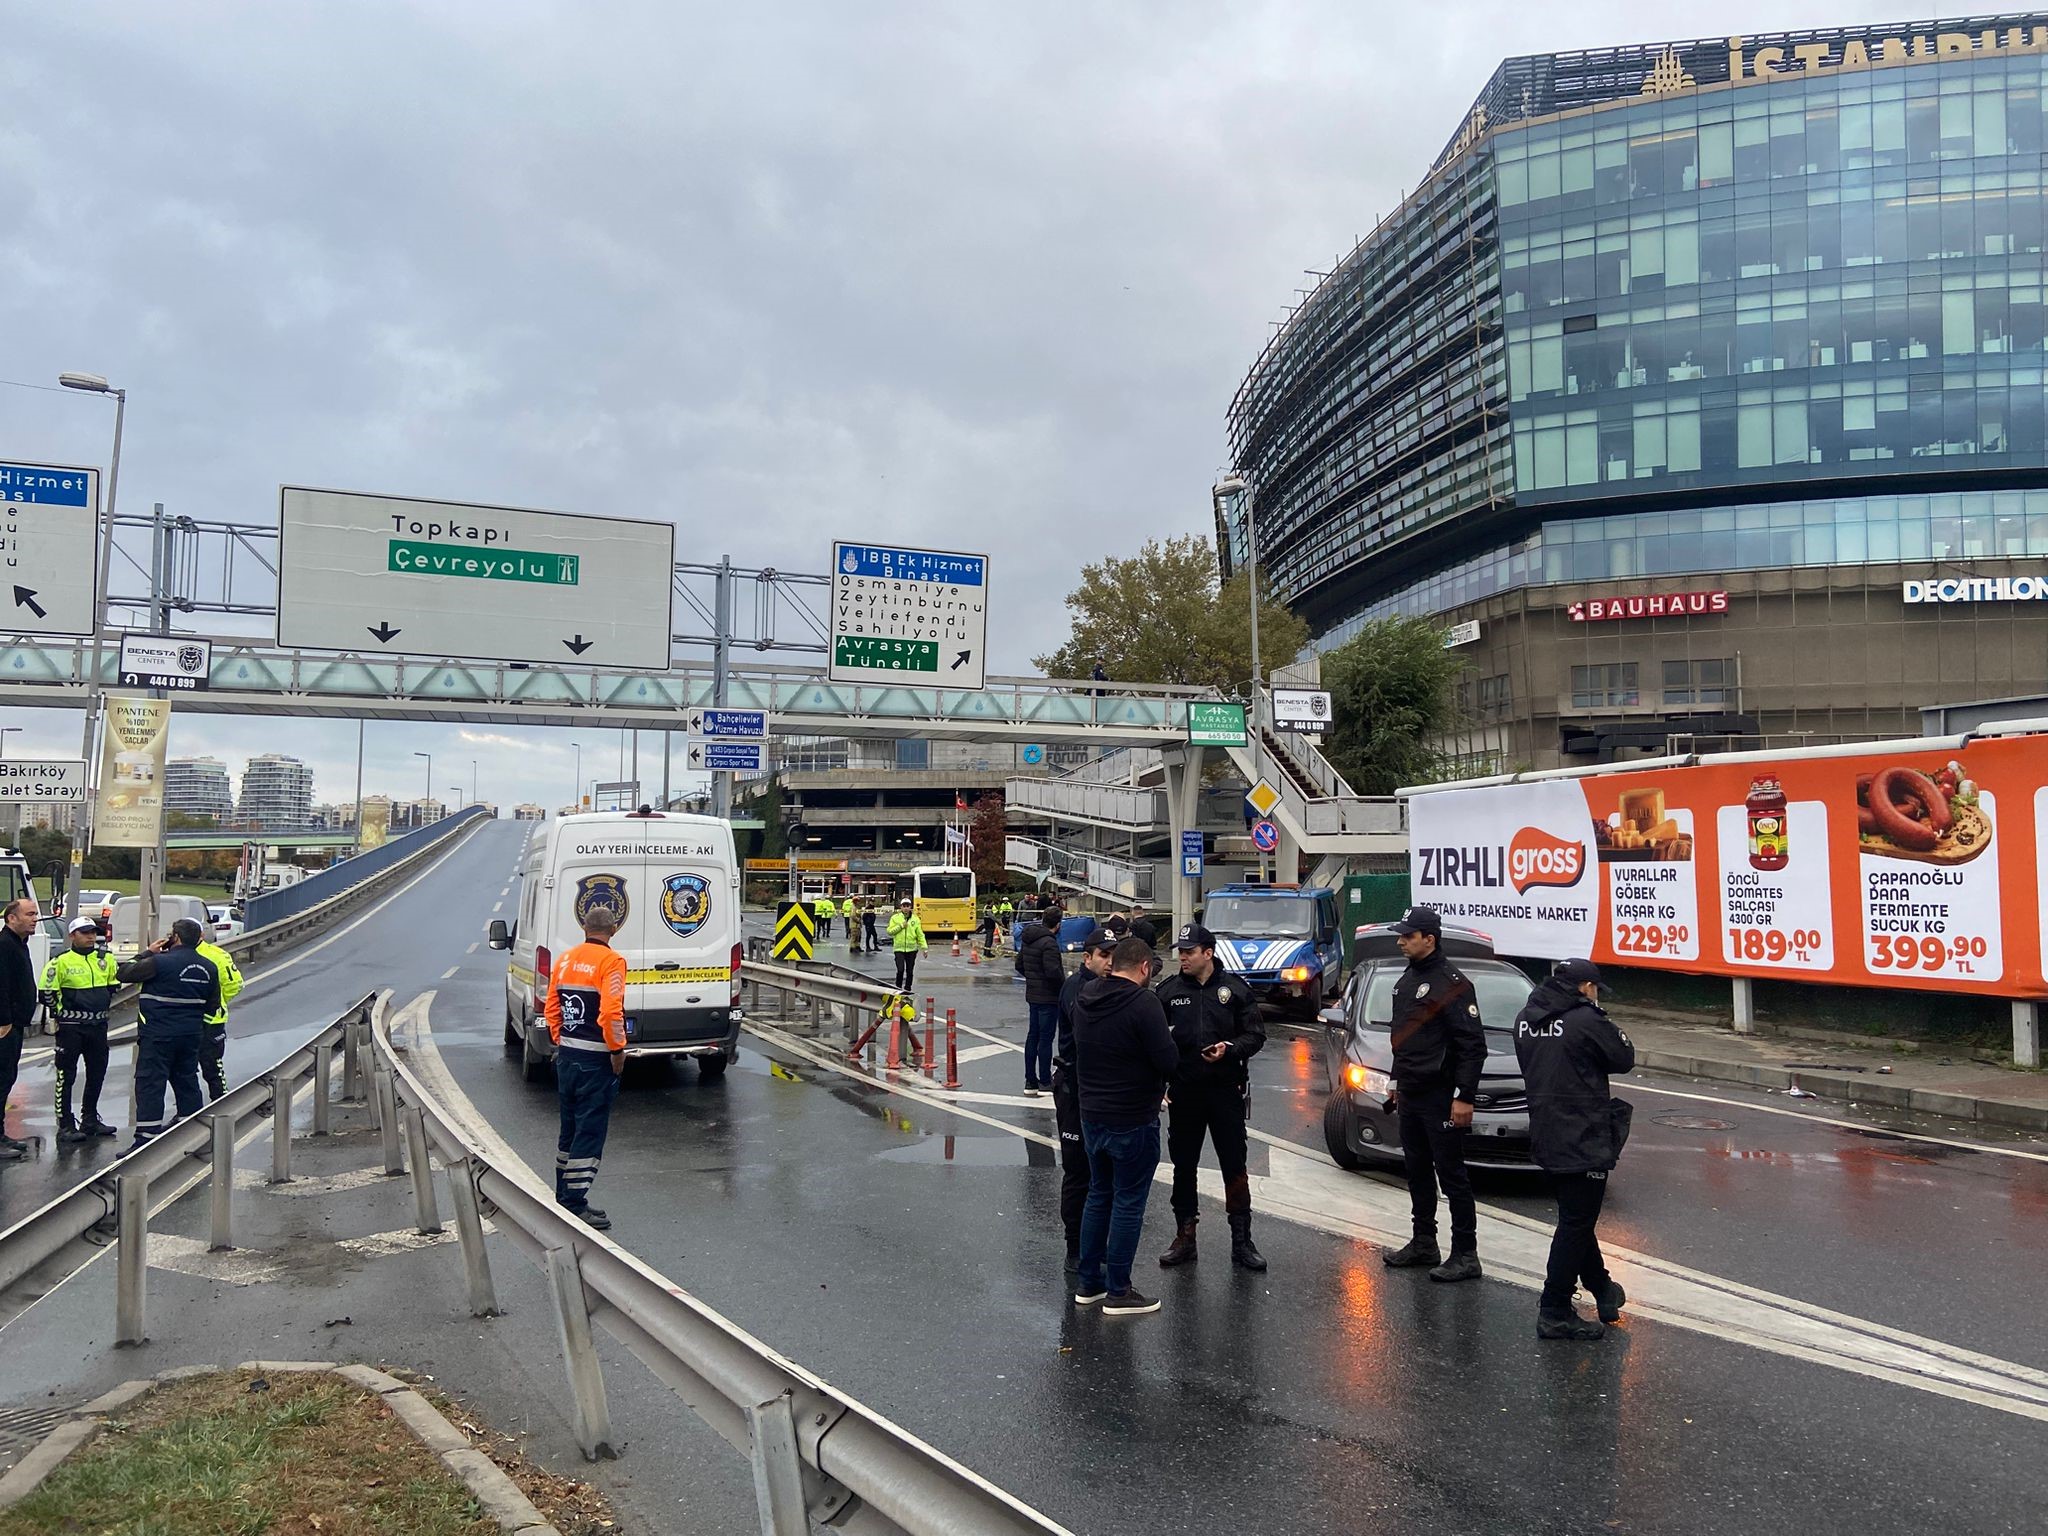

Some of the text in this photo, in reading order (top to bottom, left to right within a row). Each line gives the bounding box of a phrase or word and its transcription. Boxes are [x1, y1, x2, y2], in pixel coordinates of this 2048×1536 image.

[392, 515, 510, 544] Topkapı
[395, 548, 544, 578] Çevreyolu
[862, 548, 980, 573] İBB Ek Hizmet
[884, 566, 948, 582] Binası
[840, 575, 958, 597] Osmaniye
[840, 590, 982, 613] Zeytinburnu
[1589, 593, 1727, 617] BAUHAUS
[839, 605, 965, 626] Veliefendi
[838, 620, 965, 640] Sahilyolu
[127, 647, 177, 657] BENESTA
[837, 636, 930, 656] Avrasya
[137, 657, 166, 665] CENTER
[846, 654, 920, 671] Tüneli
[149, 675, 196, 688] 444 0 899
[117, 707, 160, 717] PANTENE
[717, 713, 760, 724] Bahçelievler
[1195, 716, 1240, 724] AVRASYA
[1294, 721, 1306, 730] 444
[1312, 722, 1325, 731] 899
[118, 727, 157, 737] YENİLENMİŞ
[714, 724, 763, 735] Yüzme Havuzu
[124, 736, 149, 745] SAÇLAR
[0, 764, 67, 781] Bakırköy
[35, 783, 83, 799] Sarayı
[576, 845, 607, 854] OLAY
[608, 844, 632, 854] YERİ
[635, 844, 688, 855] İNCELEME
[696, 845, 714, 855] AKİ
[1419, 845, 1578, 887] ZIRHLI gross
[1614, 868, 1677, 882] VURALLAR
[1727, 871, 1760, 885] ÖNCÜ
[1869, 869, 1964, 888] ÇAPANOĞLU
[1615, 885, 1657, 900] GÖBEK
[1728, 887, 1783, 899] DOMATES
[1869, 887, 1910, 901] DANA
[1459, 903, 1466, 916] &
[1468, 904, 1532, 919] PERAKENDE
[1537, 906, 1588, 922] MARKET
[1616, 903, 1676, 921] KAŞAR KG
[1728, 900, 1775, 914] SALÇASI
[1870, 903, 1949, 918] FERMENTE
[1729, 914, 1772, 926] 4300 GR
[1870, 919, 1946, 934] SUCUK KG
[1667, 943, 1680, 955] TL
[1795, 950, 1811, 962] TL
[1956, 961, 1975, 974] TL
[693, 971, 724, 979] İNCELEME
